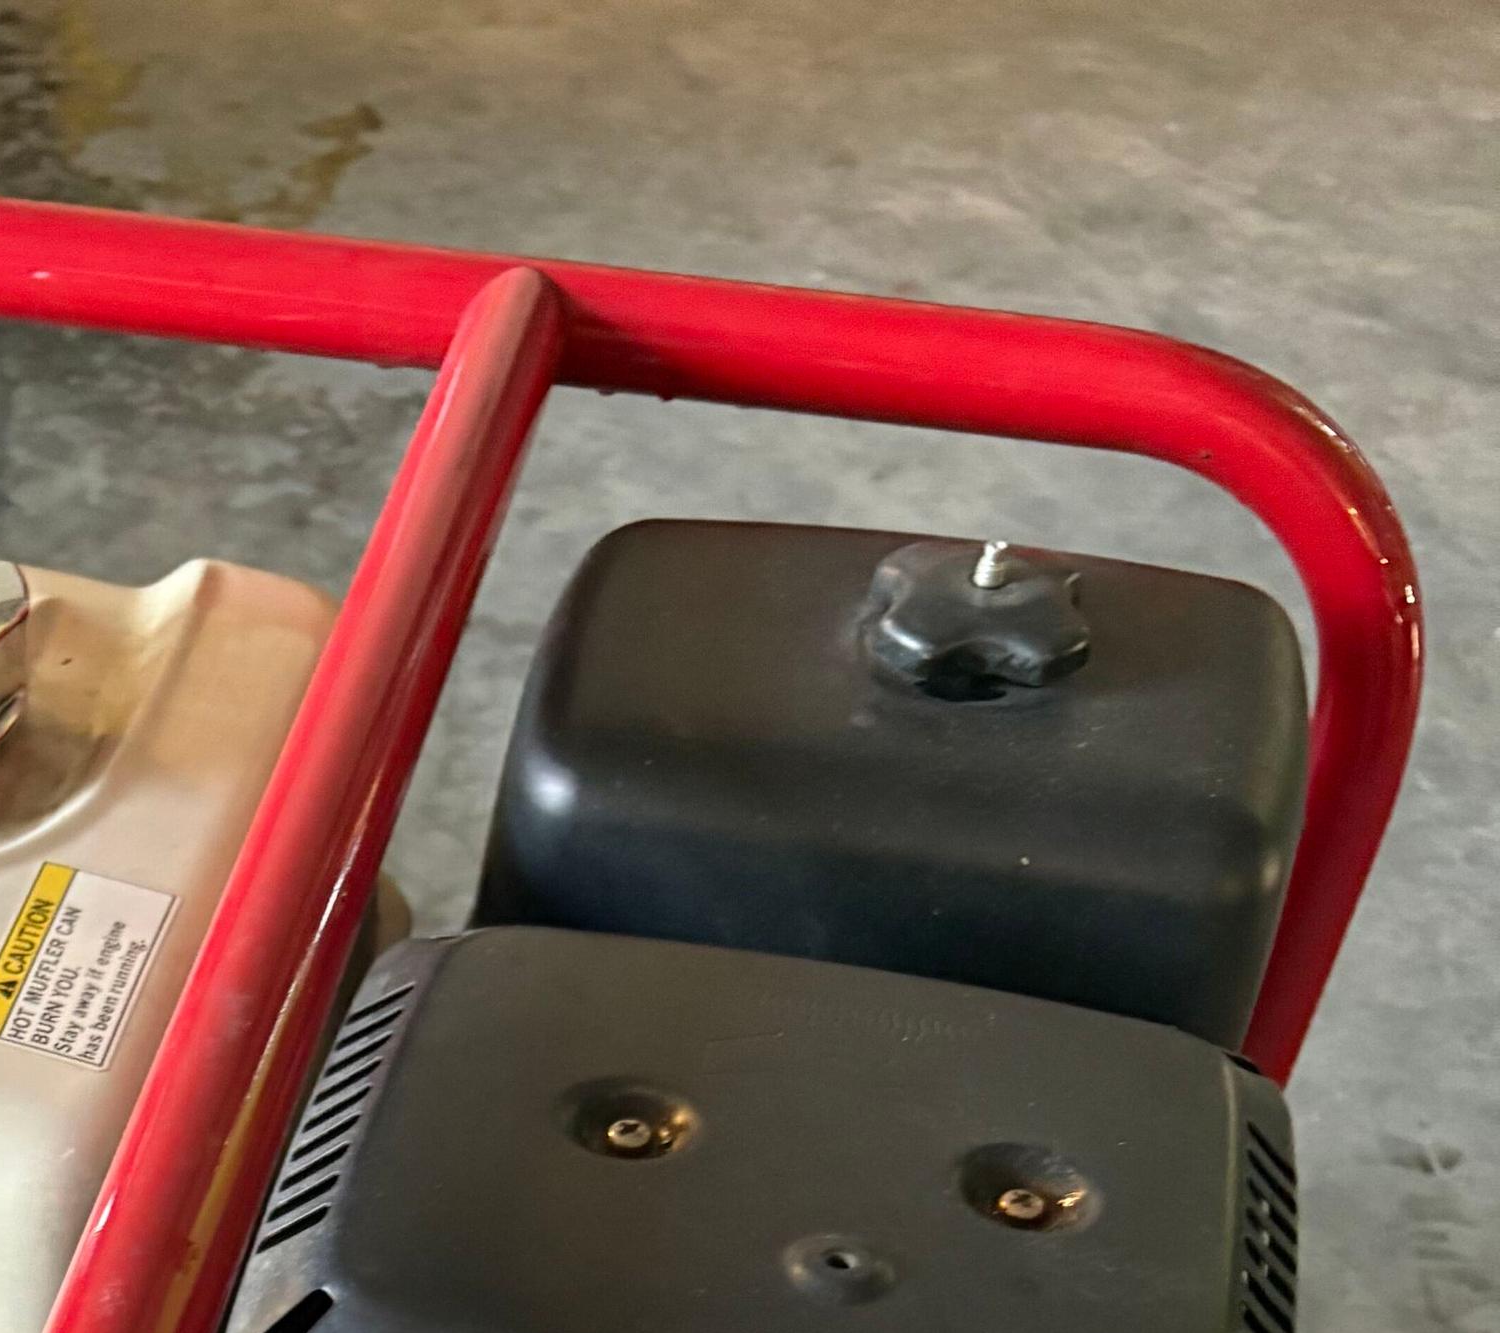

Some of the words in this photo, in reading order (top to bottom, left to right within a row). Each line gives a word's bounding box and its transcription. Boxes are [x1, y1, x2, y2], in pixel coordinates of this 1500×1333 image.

[2, 899, 55, 975] CAUTION
[94, 920, 129, 965] engine
[7, 1007, 35, 1040] HOT
[22, 938, 67, 1004] MUFFLER
[55, 905, 82, 936] CAN
[85, 967, 104, 979] if
[110, 940, 147, 995] running.
[31, 1001, 64, 1045] BURN
[52, 963, 81, 998] YOU.
[73, 980, 102, 1018] away
[90, 995, 118, 1030] been
[53, 1020, 84, 1053] Stay
[78, 1033, 103, 1060] has
